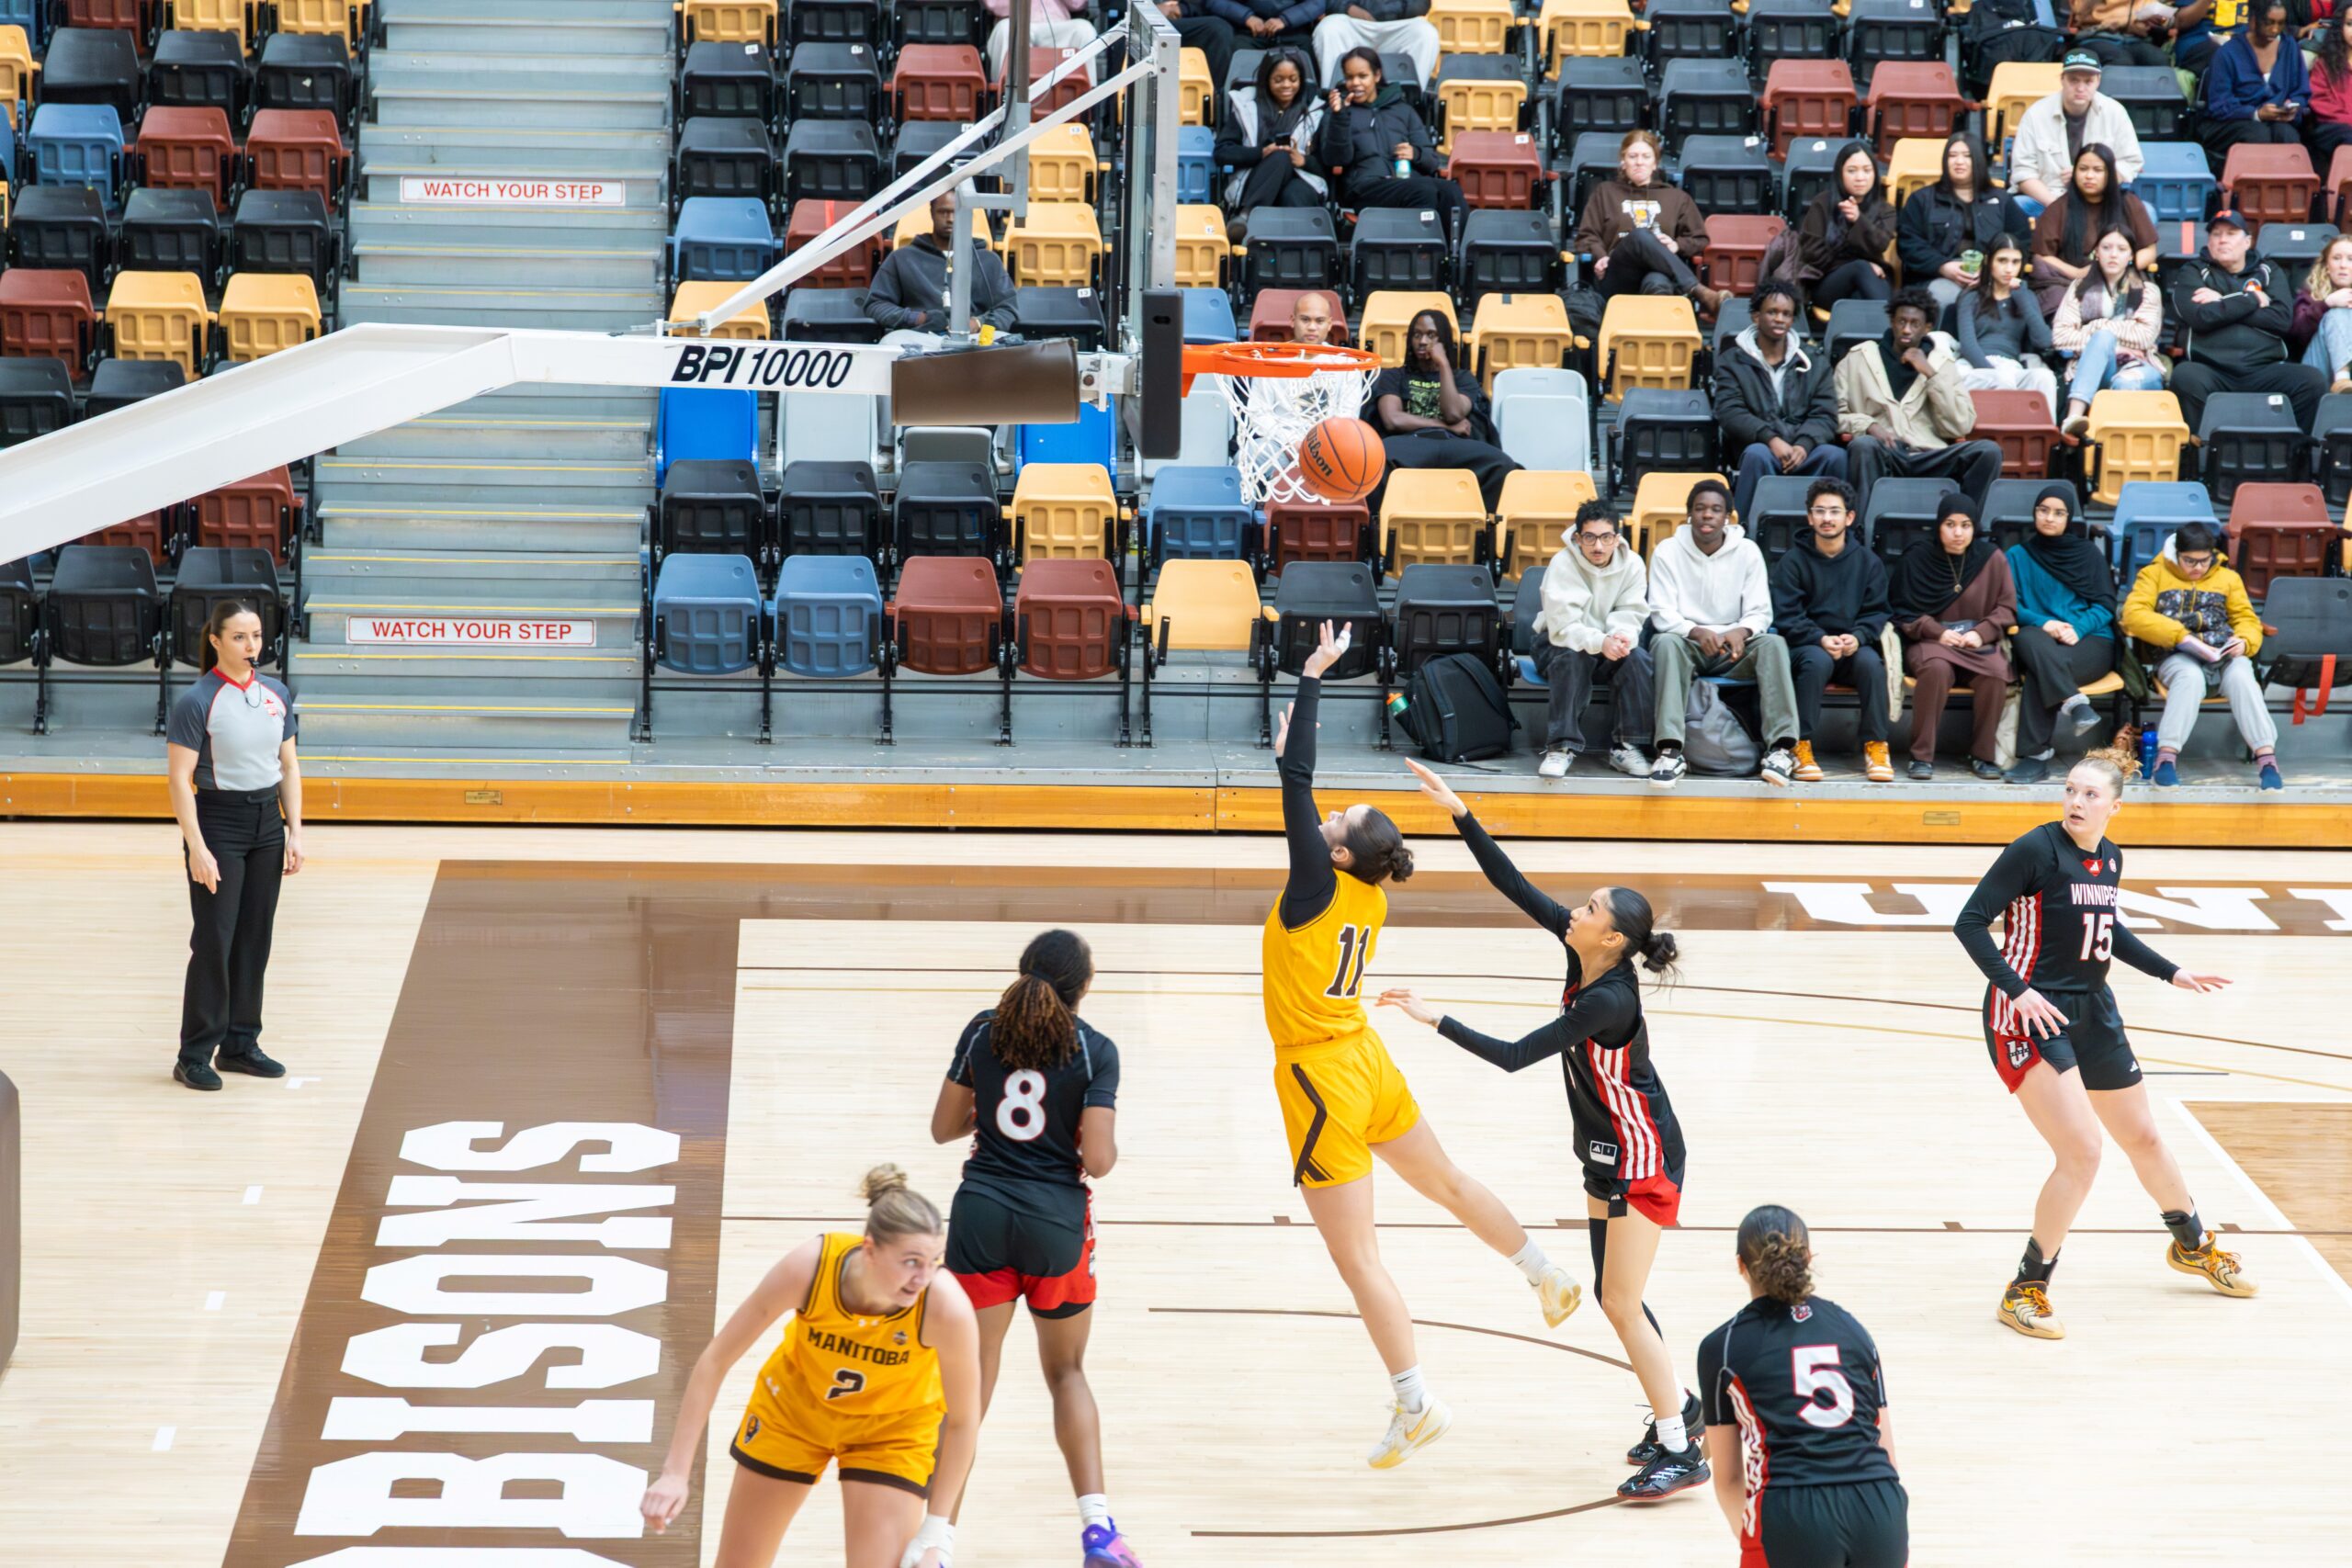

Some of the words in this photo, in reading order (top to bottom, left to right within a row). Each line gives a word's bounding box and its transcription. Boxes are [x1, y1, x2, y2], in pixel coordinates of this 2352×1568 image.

[424, 182, 490, 197] WATCH
[496, 183, 548, 198] YOUR
[555, 185, 604, 199] STEP
[671, 345, 746, 384] BPI
[748, 348, 854, 389] 10000
[1306, 425, 1333, 477] Wilson
[371, 621, 445, 637] WATCH
[453, 622, 511, 638] YOUR
[518, 624, 572, 640] STEP
[1323, 923, 1371, 998] 11
[2079, 912, 2114, 962] 15
[996, 1068, 1046, 1142] 8
[283, 1121, 681, 1568] BISONS
[808, 1325, 910, 1366] MANITOBA
[824, 1367, 867, 1401] 2
[1792, 1343, 1855, 1428] 5
